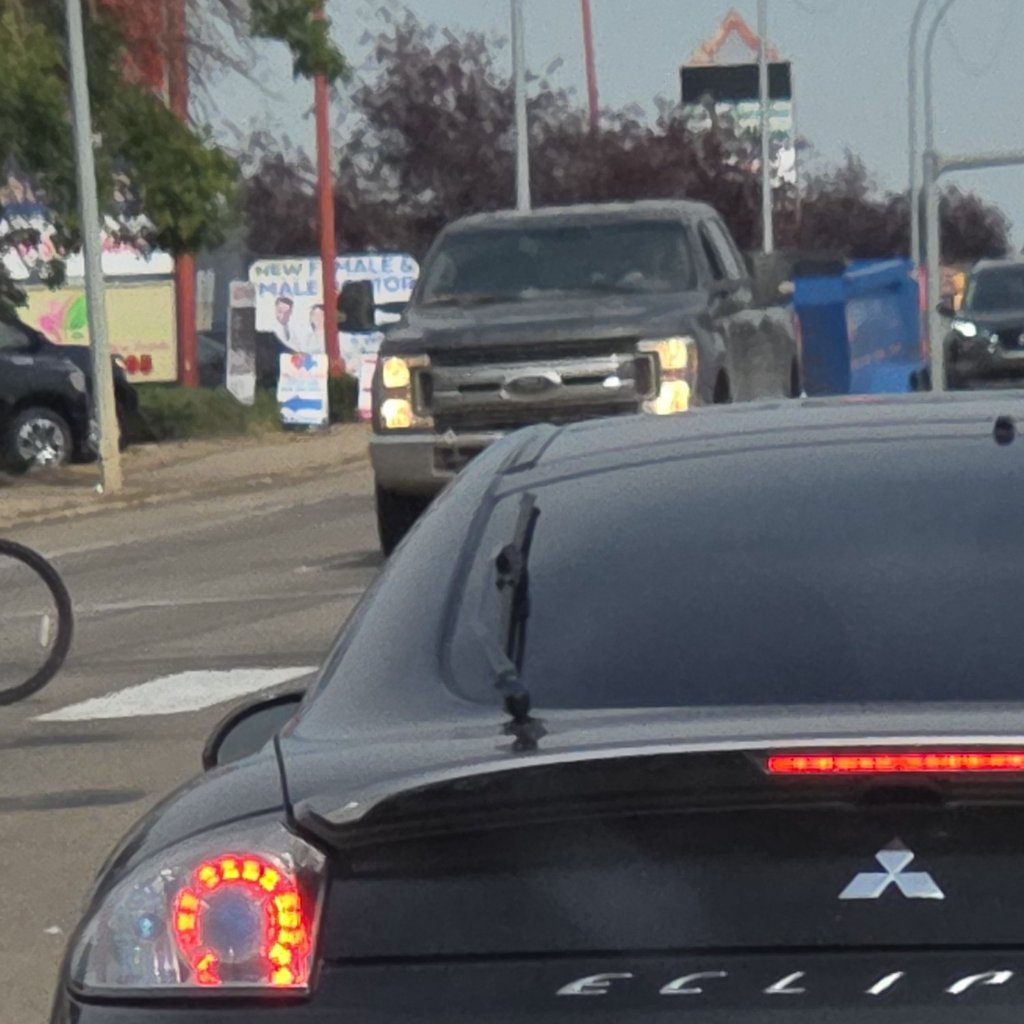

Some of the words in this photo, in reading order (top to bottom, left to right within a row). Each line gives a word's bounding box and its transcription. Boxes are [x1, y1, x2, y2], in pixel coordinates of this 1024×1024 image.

[255, 264, 302, 276] NEW
[310, 257, 392, 274] FMALE
[259, 281, 317, 296] MALE
